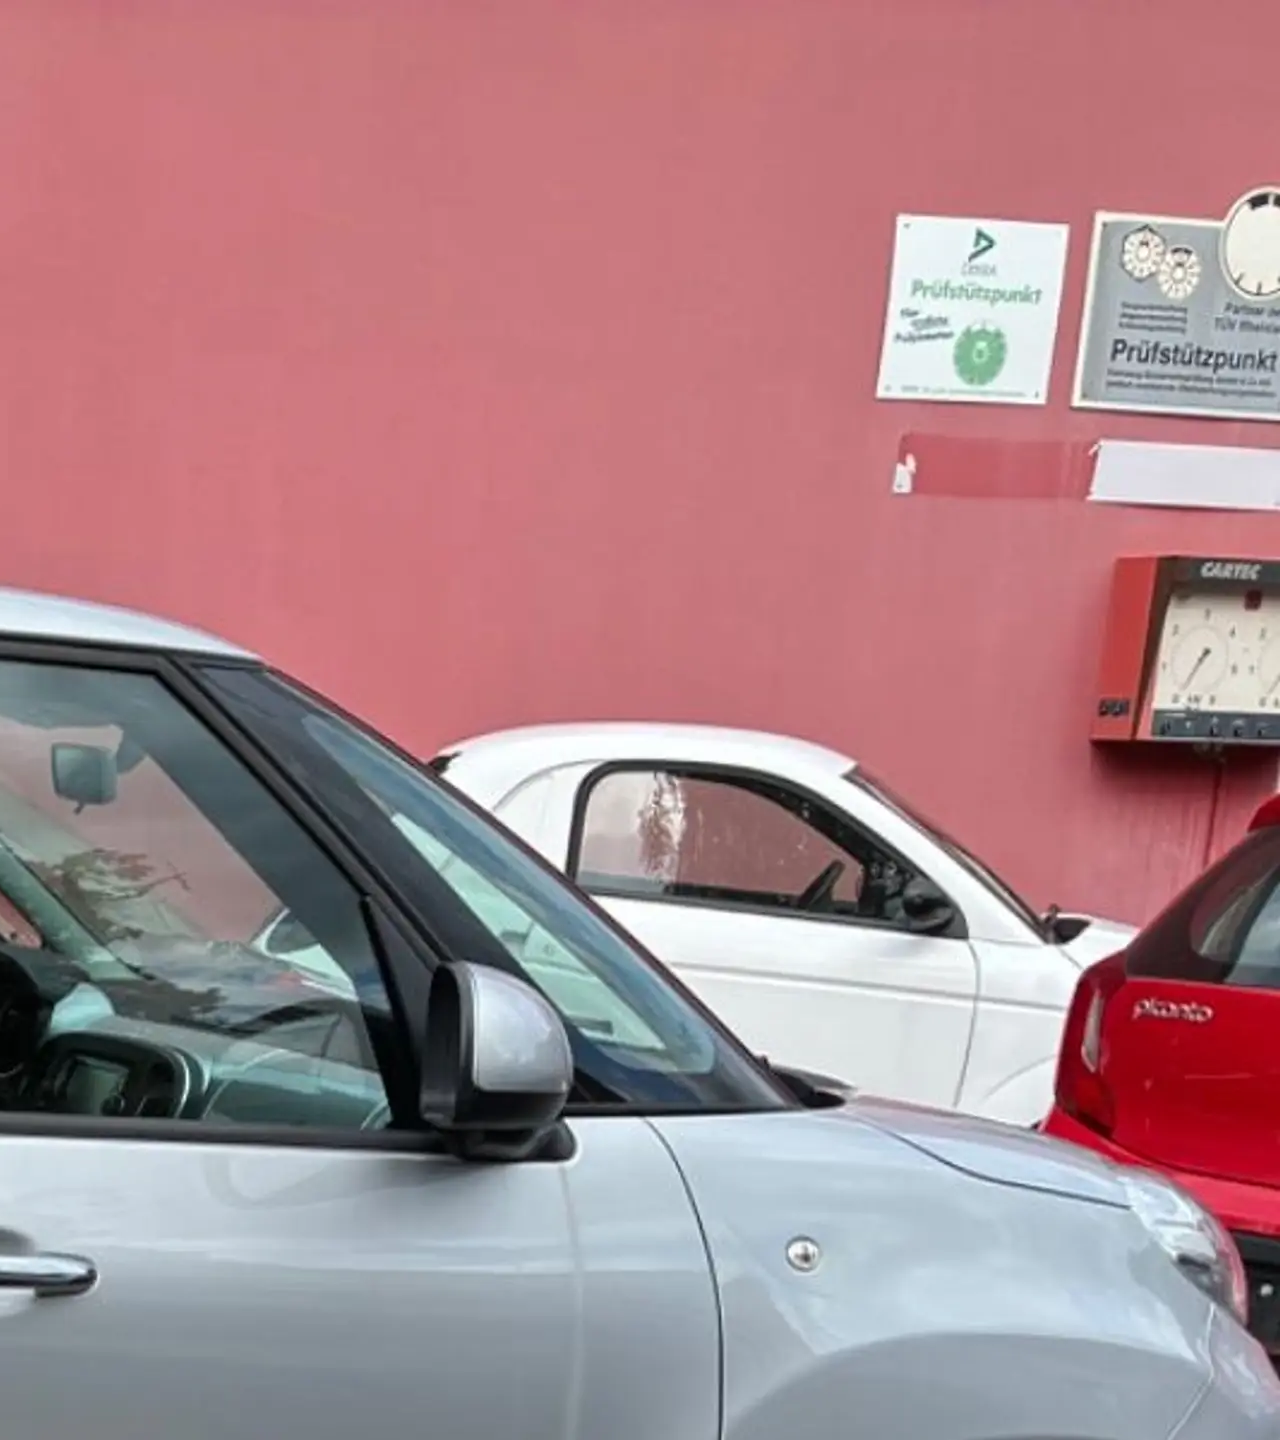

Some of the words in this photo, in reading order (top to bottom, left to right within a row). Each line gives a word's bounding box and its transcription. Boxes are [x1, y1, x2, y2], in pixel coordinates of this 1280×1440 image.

[910, 278, 1043, 307] Prüfstützpunkt
[1109, 338, 1278, 374] Prüfstützpunkt
[1200, 560, 1262, 581] CARTEC
